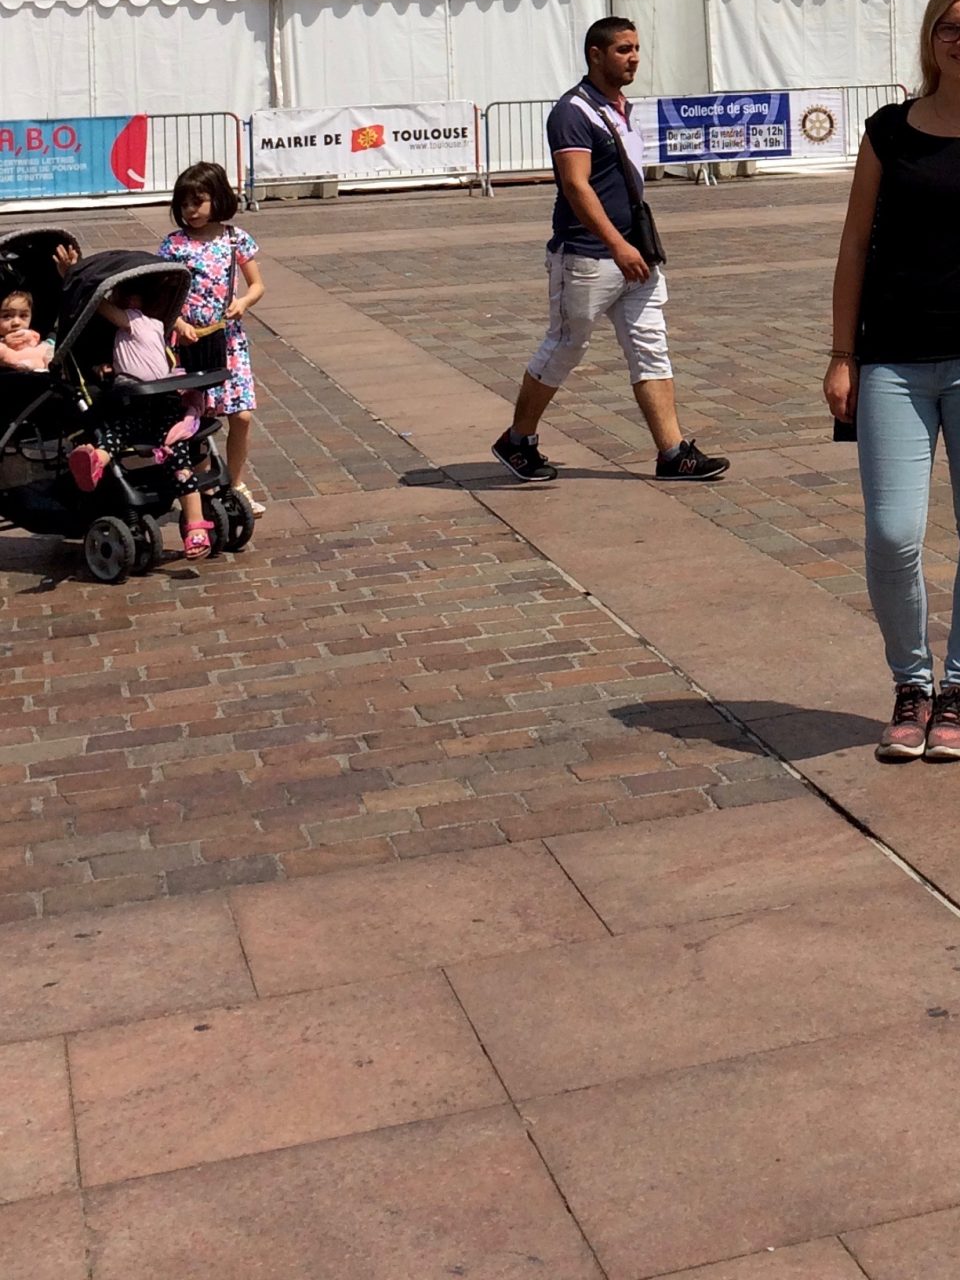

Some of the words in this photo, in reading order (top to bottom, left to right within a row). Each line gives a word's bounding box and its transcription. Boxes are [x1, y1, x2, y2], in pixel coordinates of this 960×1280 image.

[680, 104, 724, 118] Collecte
[727, 102, 740, 114] de
[743, 103, 769, 115] sang
[680, 130, 702, 141] mardi
[752, 126, 763, 137] De
[767, 126, 783, 136] 12h
[261, 134, 317, 150] MAIRIE
[323, 133, 342, 146] DE
[392, 127, 468, 142] TOULOUSE
[754, 137, 760, 147] à
[763, 137, 781, 147] 19h
[680, 141, 701, 152] juillet
[711, 141, 720, 149] 21
[722, 140, 743, 150] juillet
[17, 166, 38, 174] PLUS
[39, 165, 50, 173] DE
[52, 163, 87, 173] POUVOIR
